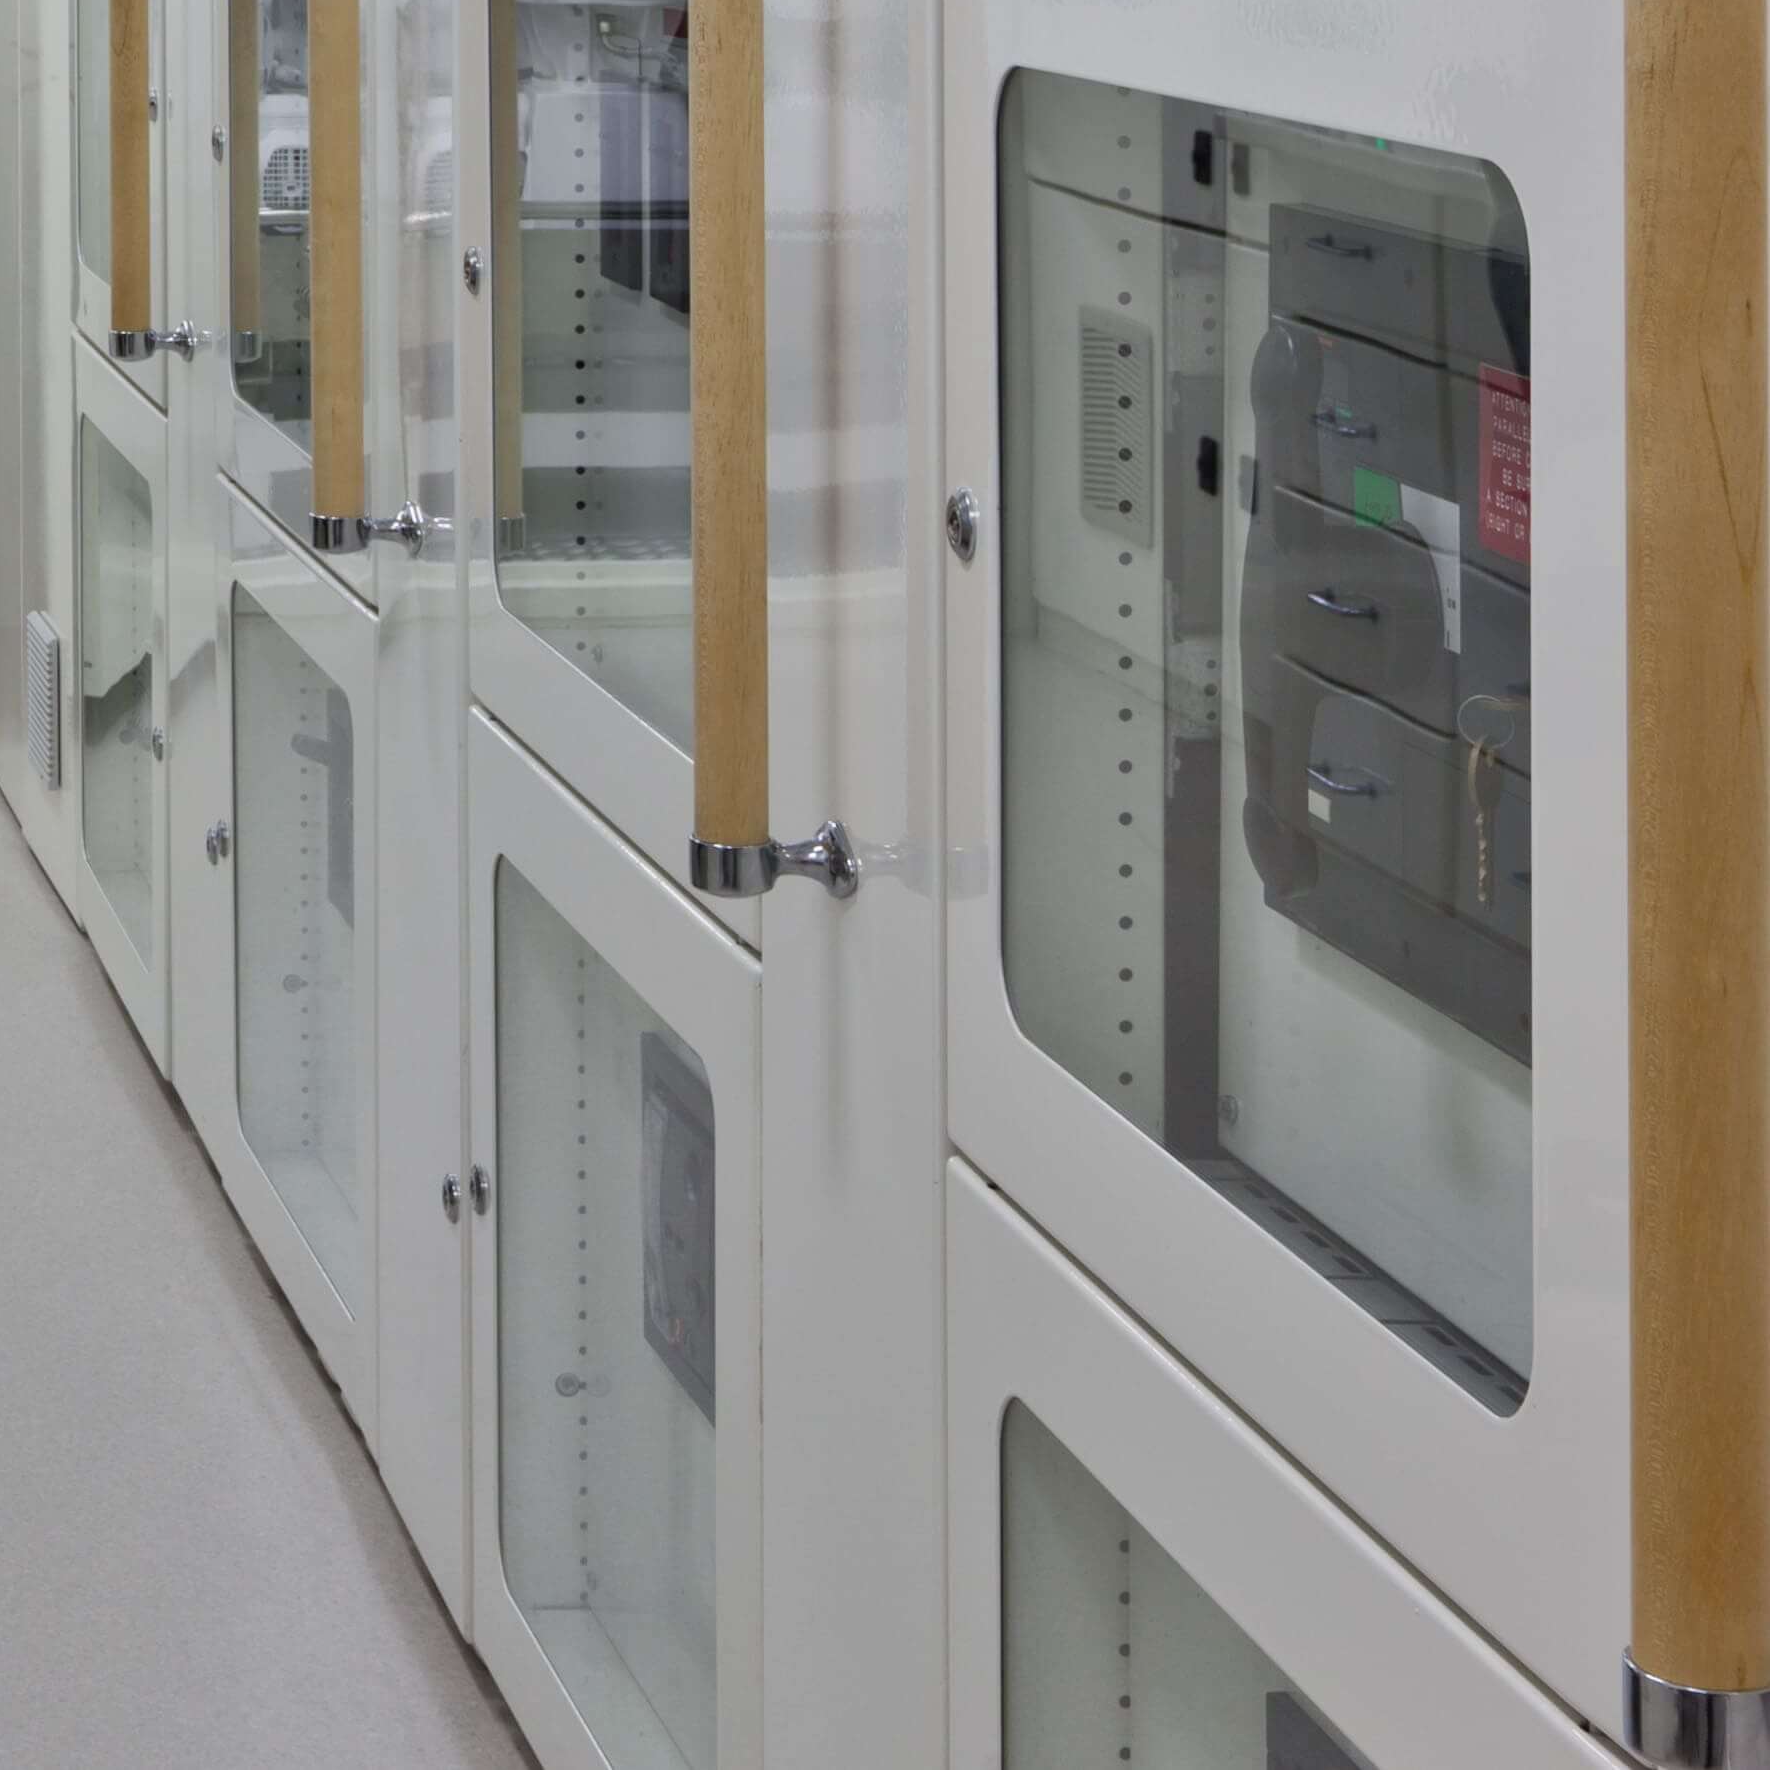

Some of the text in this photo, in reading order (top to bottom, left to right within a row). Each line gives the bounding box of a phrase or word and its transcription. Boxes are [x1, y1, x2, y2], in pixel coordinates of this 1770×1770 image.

[1491, 439, 1522, 466] BEFORE
[1502, 467, 1513, 487] BE
[1486, 488, 1528, 517] A SECTION
[1514, 522, 1526, 541] OR
